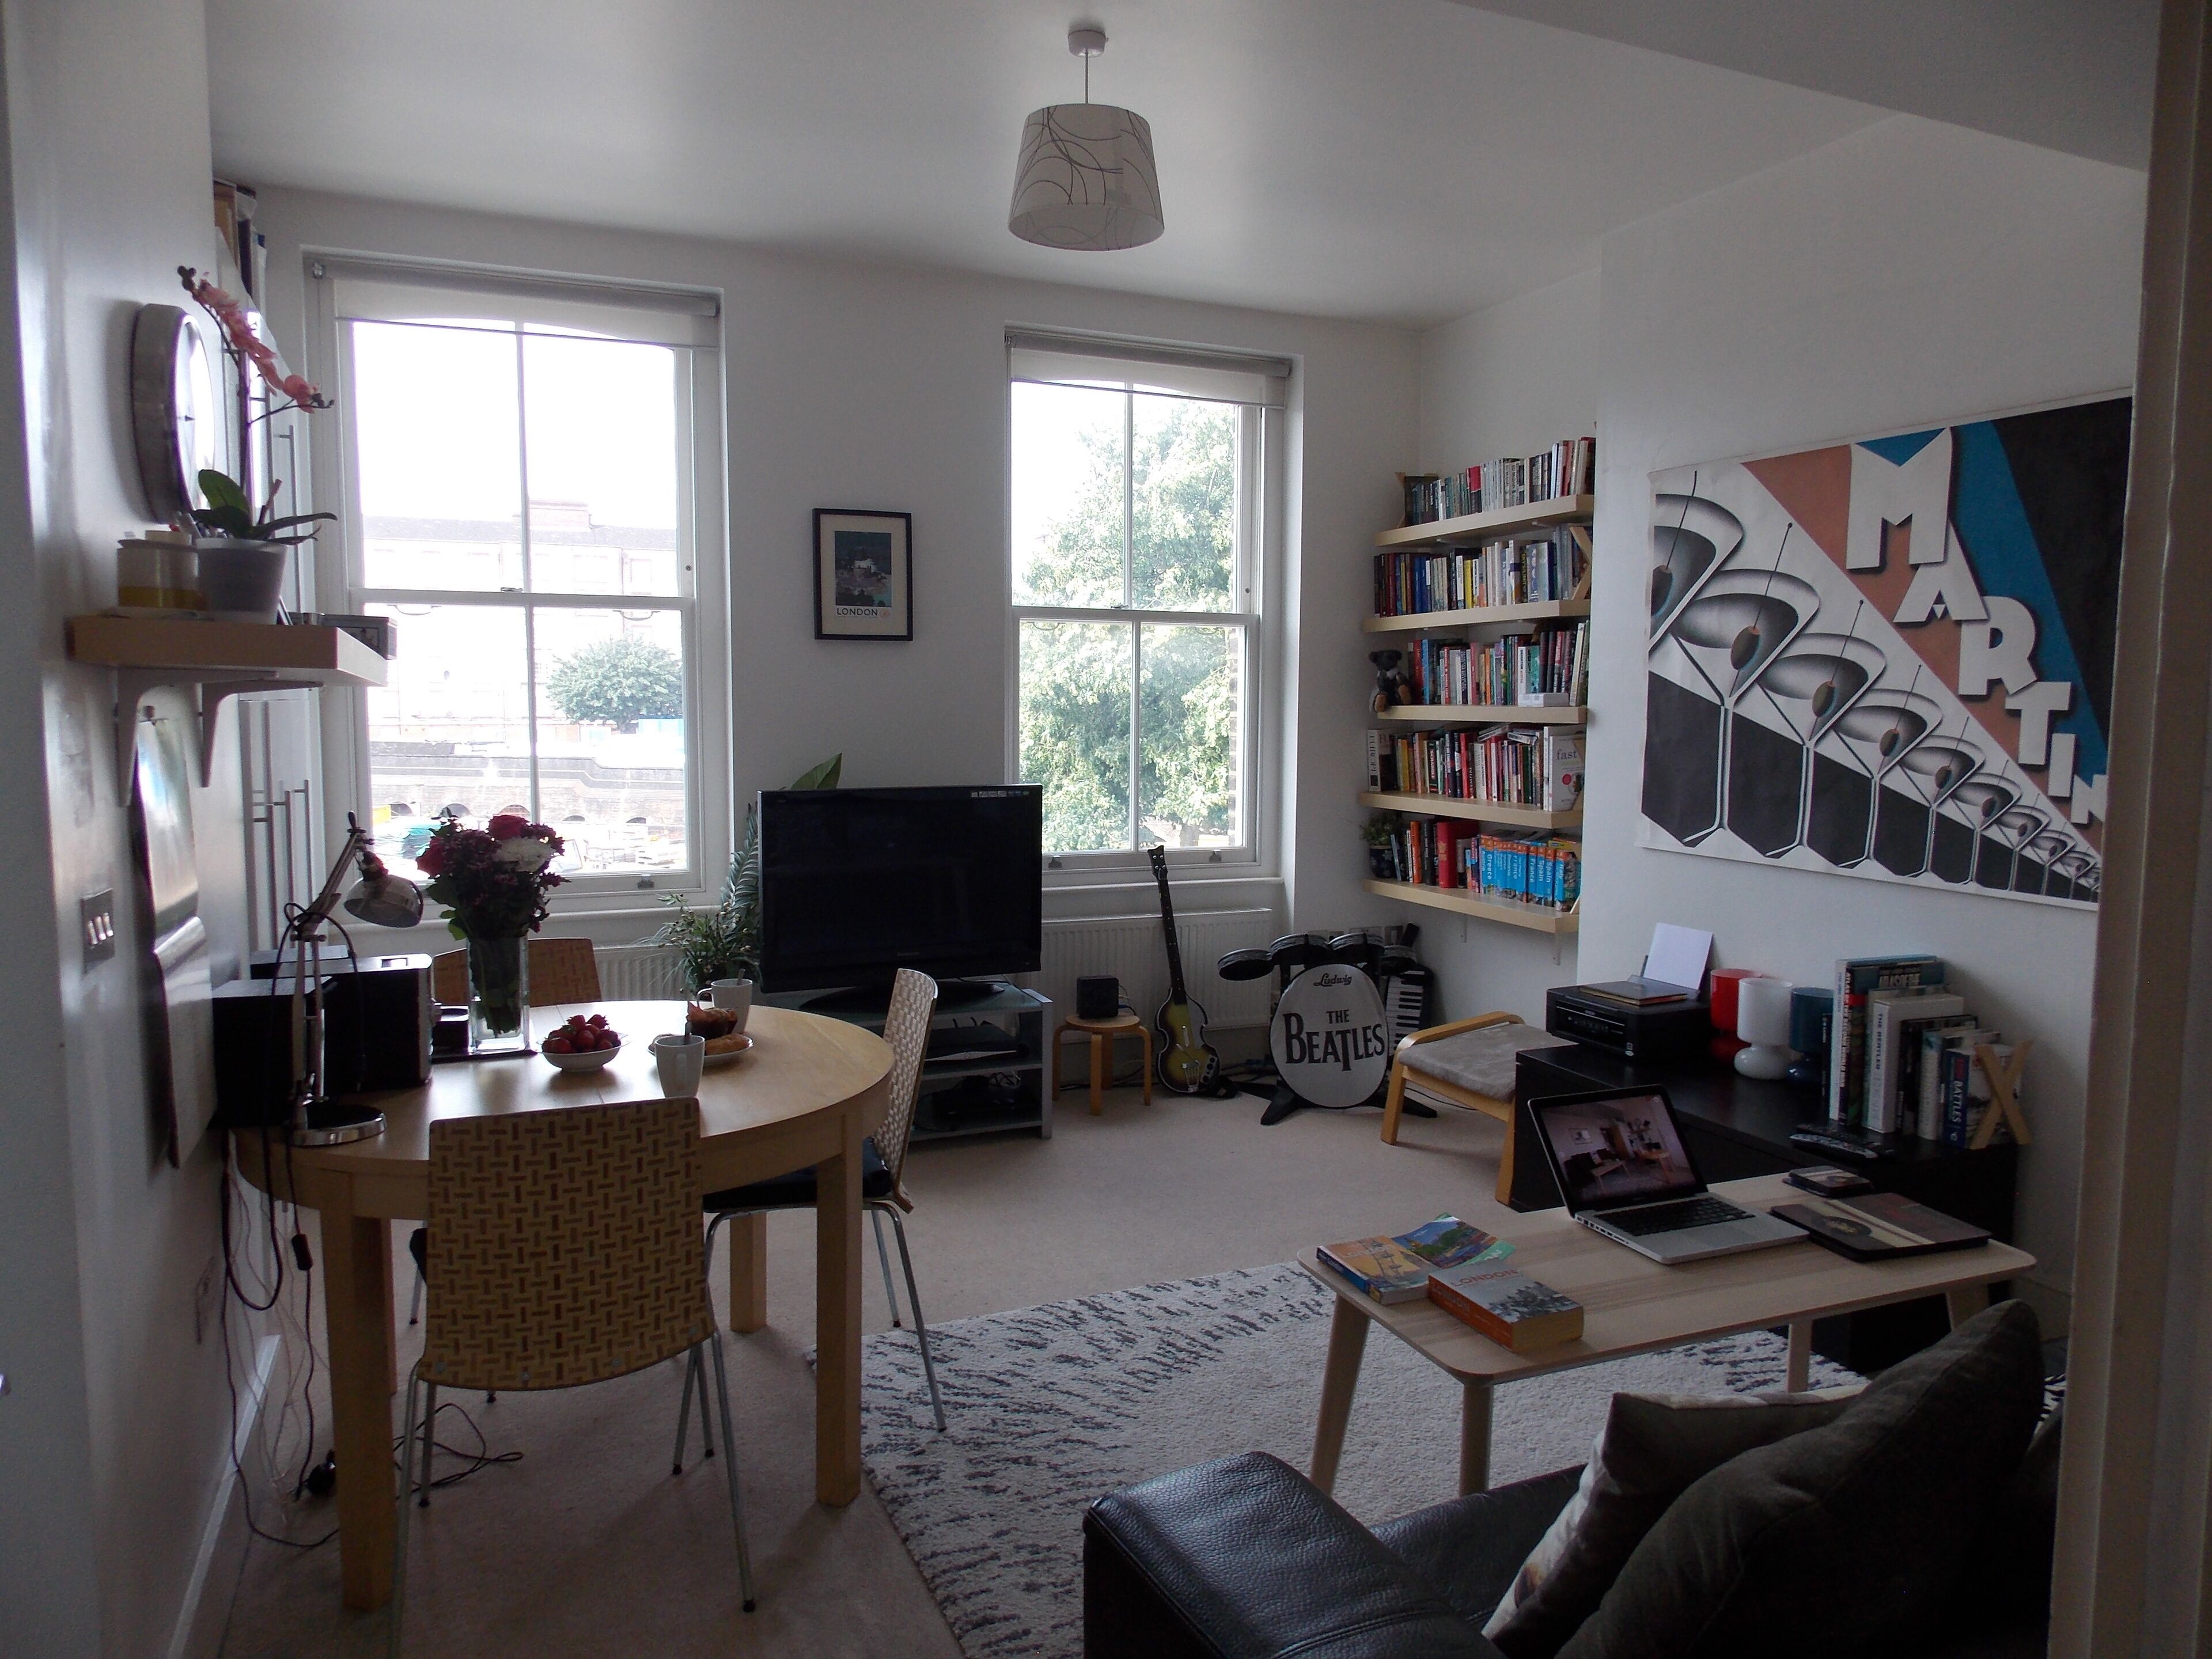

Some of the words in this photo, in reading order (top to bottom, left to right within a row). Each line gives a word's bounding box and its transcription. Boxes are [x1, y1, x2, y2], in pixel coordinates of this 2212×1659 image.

[836, 608, 878, 616] LONDON
[1556, 749, 1577, 760] fast
[1313, 973, 1353, 987] Ludwig
[1326, 1009, 1350, 1024] THE
[1283, 1013, 1385, 1071] BEATLES
[1952, 1080, 1963, 1123] BATTLES
[1450, 1268, 1518, 1286] LONDON
